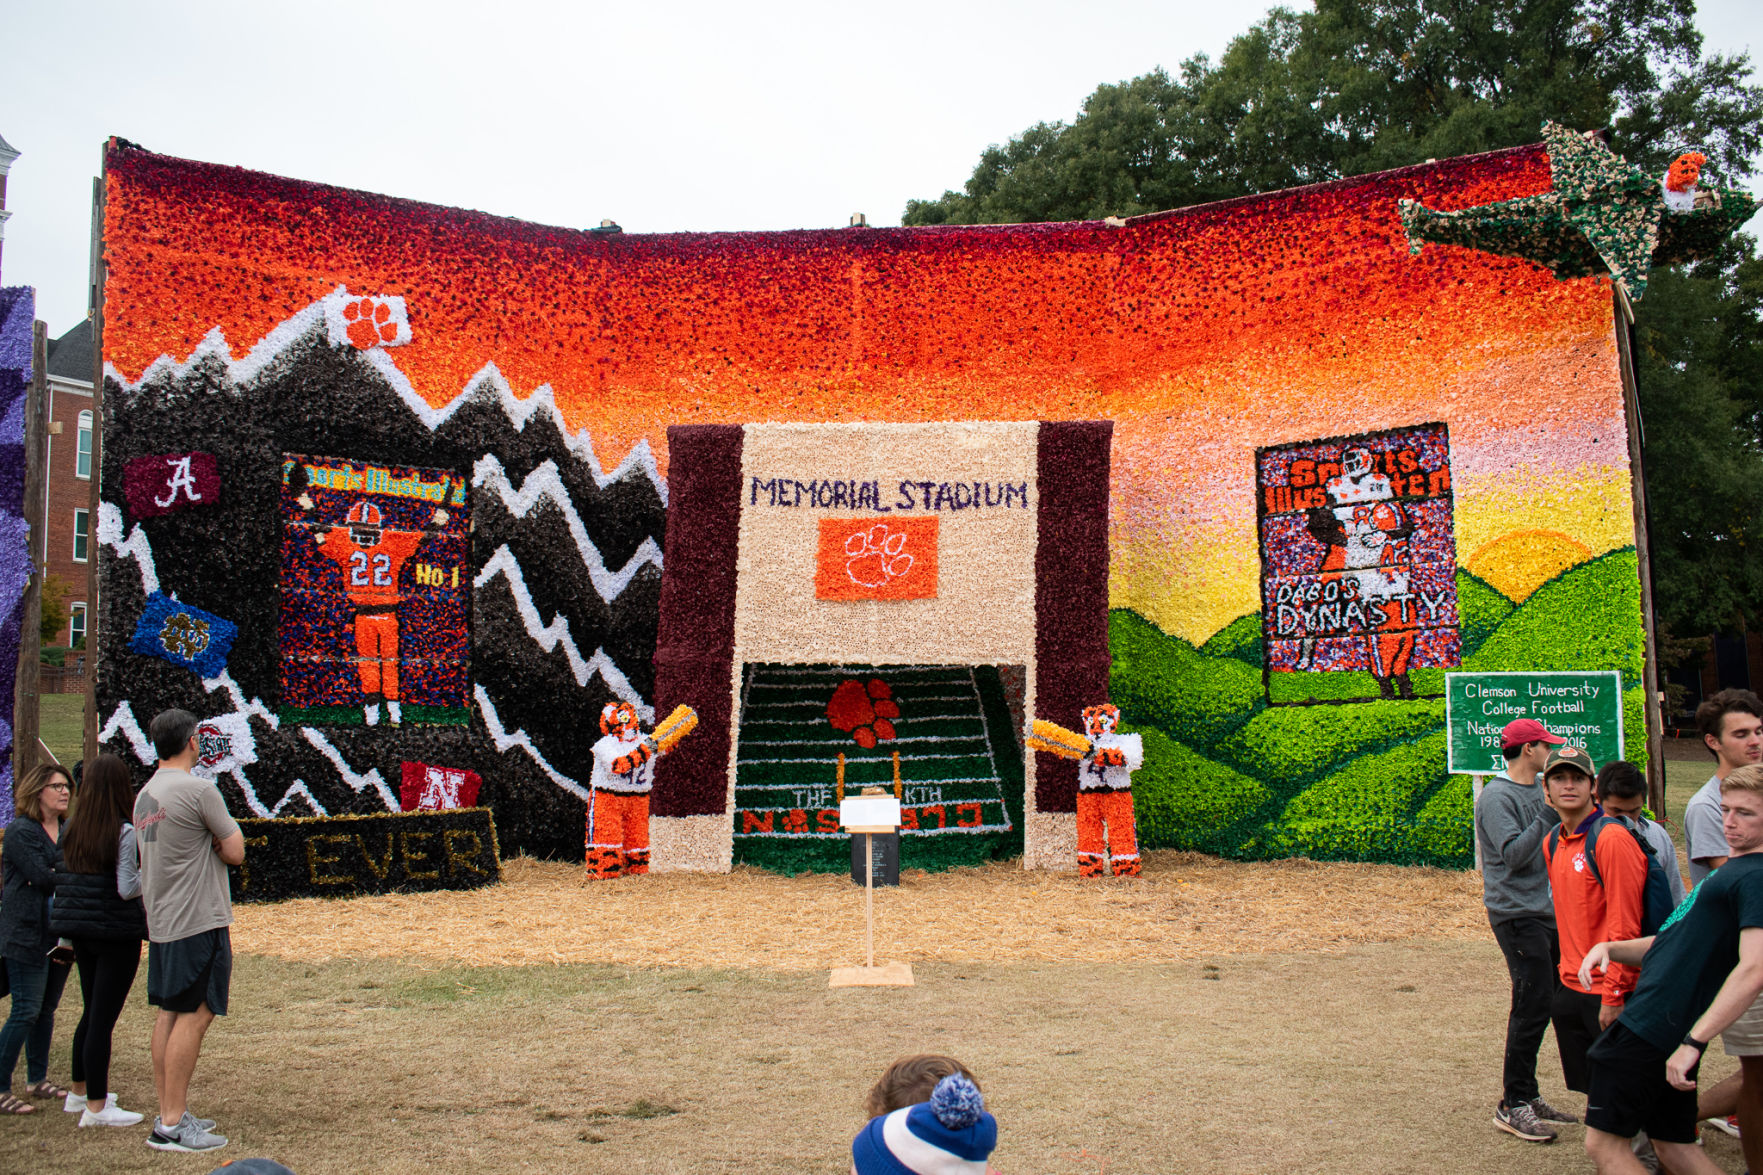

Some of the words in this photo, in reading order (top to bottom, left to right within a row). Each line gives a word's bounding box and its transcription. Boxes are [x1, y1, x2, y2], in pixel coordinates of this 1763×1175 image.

[155, 456, 202, 507] A
[750, 477, 892, 511] MEMORIAL
[896, 479, 1028, 511] STADIUM
[349, 550, 393, 586] 22
[1276, 579, 1360, 603] DABO'S
[1276, 590, 1446, 635] DYNASTY
[1465, 683, 1517, 698] Clemson
[1528, 680, 1600, 699] University
[1482, 700, 1527, 718] College
[1531, 700, 1585, 714] Football
[1467, 720, 1503, 736] Nation
[1480, 736, 1501, 748] 198
[1562, 736, 1588, 749] 2016
[418, 767, 466, 809] N
[306, 830, 489, 885] EVER
